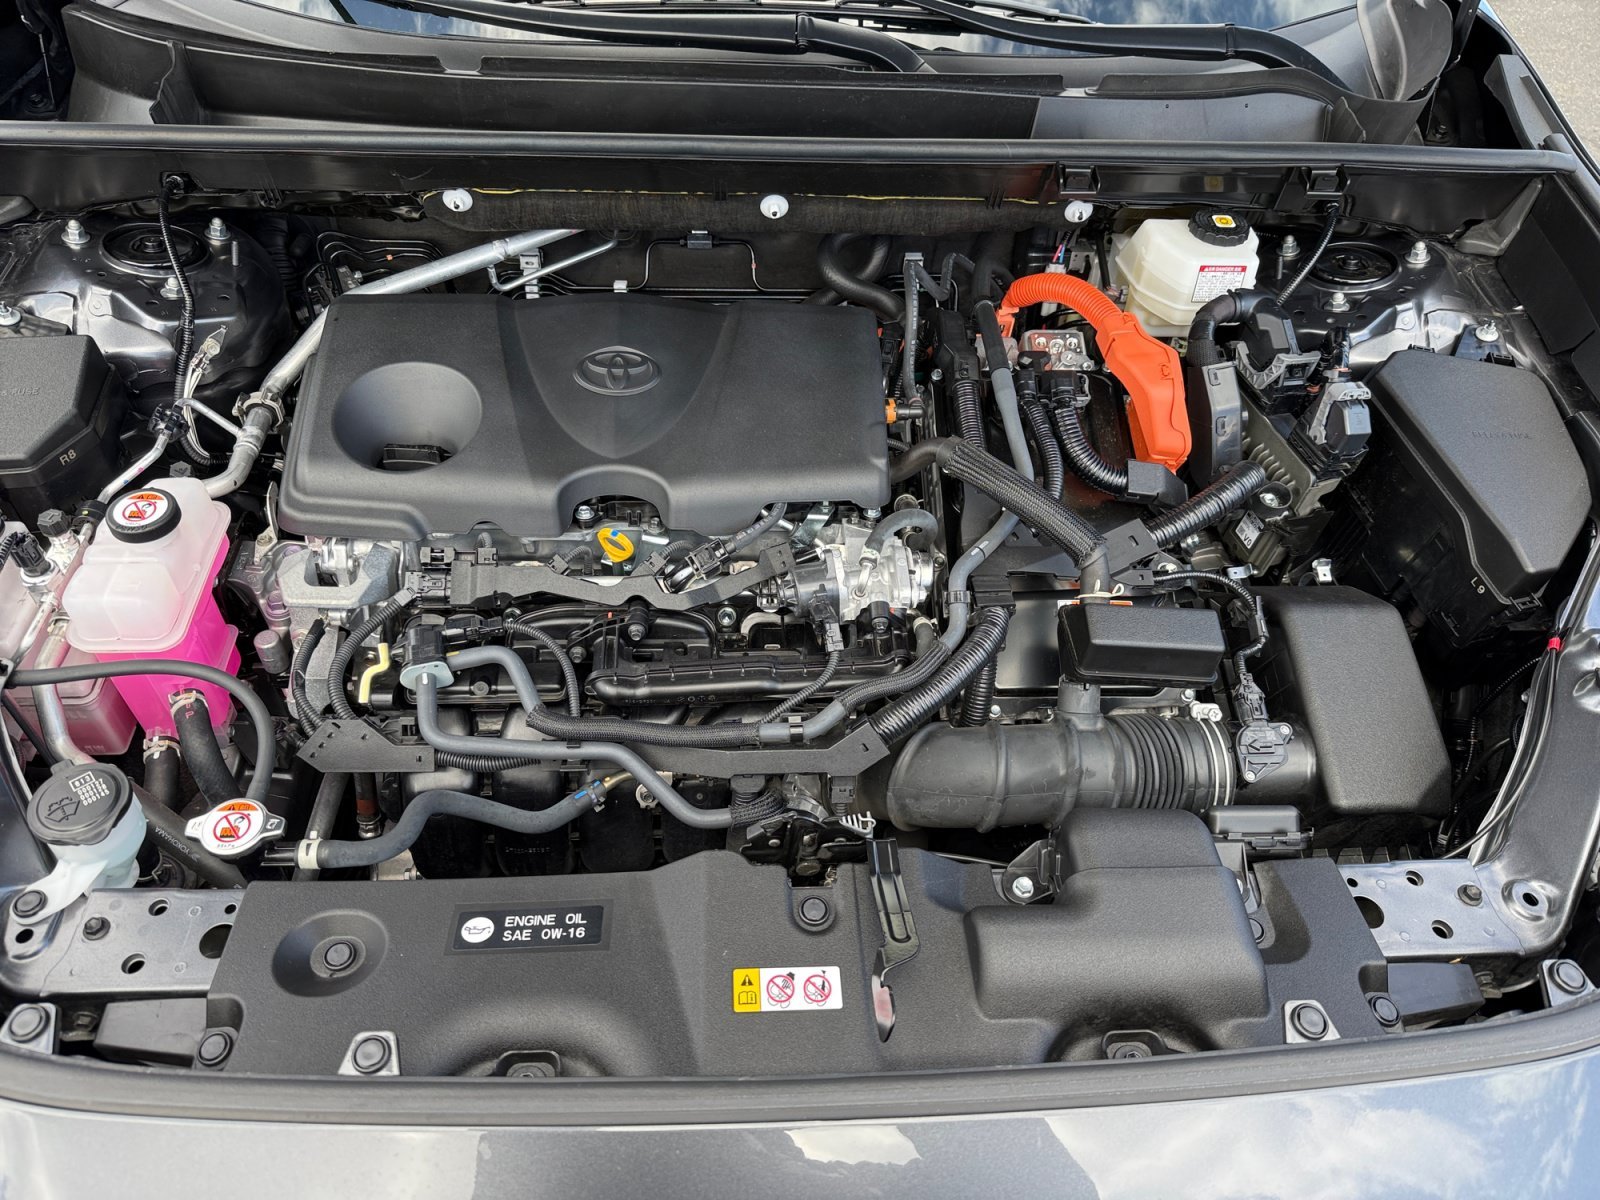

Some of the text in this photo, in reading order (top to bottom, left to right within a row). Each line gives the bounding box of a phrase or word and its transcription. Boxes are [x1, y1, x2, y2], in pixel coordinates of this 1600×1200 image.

[59, 449, 77, 466] R8
[155, 826, 190, 854] YOKOHAMA
[504, 913, 588, 927] ENGINE OIL
[502, 929, 532, 941] SAE
